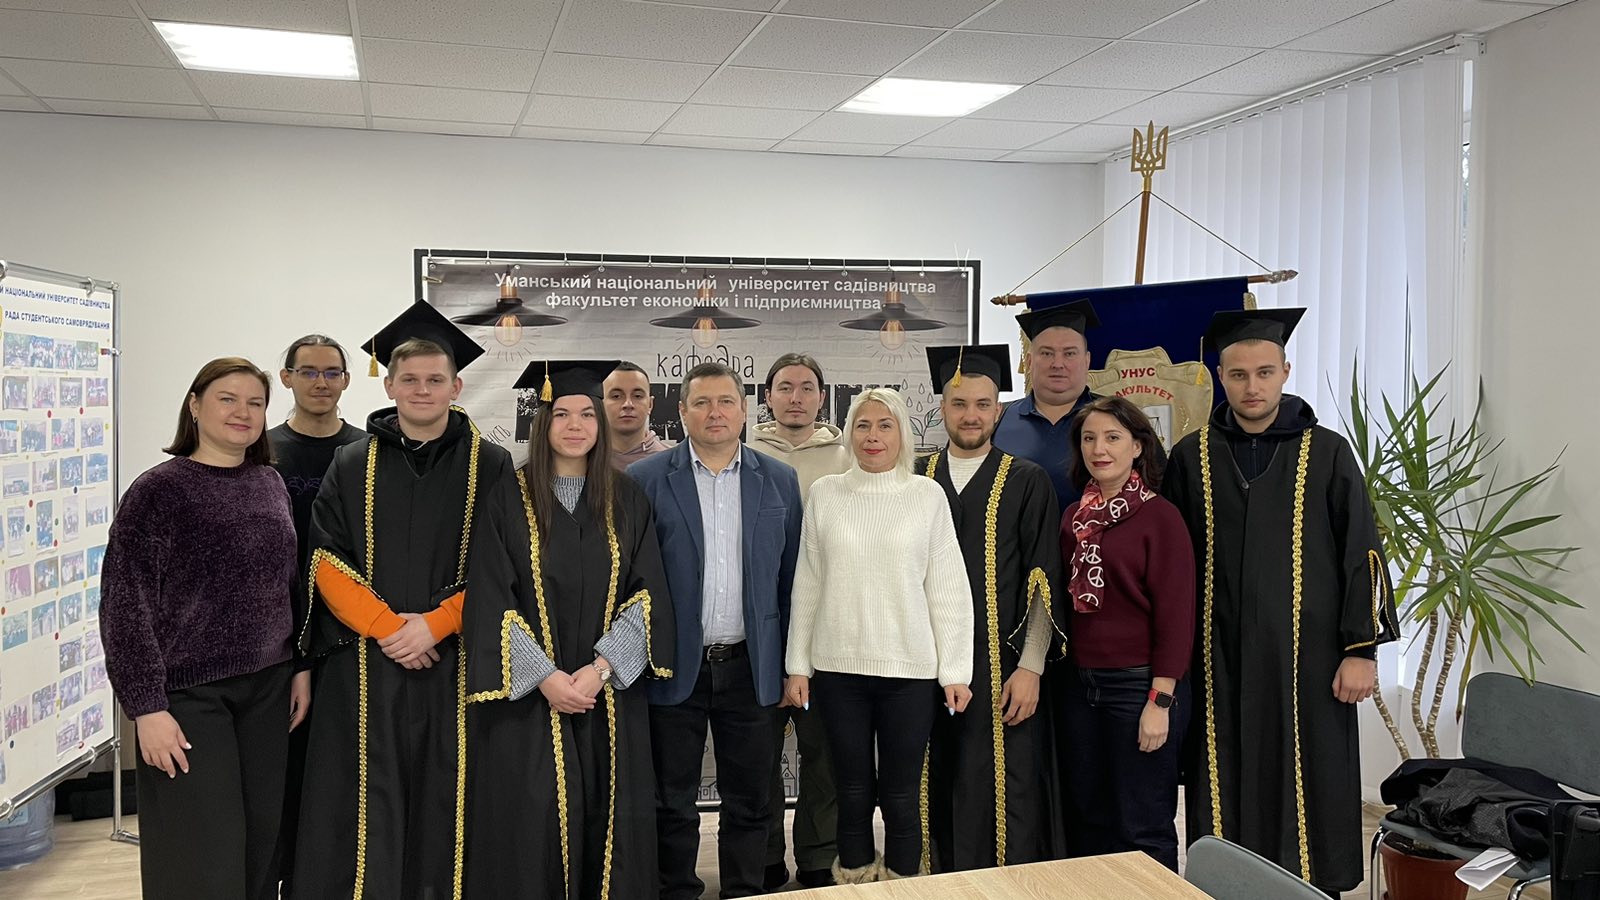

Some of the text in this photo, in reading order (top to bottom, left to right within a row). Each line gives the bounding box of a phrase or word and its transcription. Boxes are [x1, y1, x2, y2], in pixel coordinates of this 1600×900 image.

[494, 273, 937, 296] Уманський національний університет садівництва
[4, 286, 46, 299] НАЦІОНАЛЬНИЙ
[46, 294, 79, 304] УНІВЕРСИТЕТ
[79, 298, 111, 309] САДІВНИЦТВА
[545, 292, 638, 310] факультет
[642, 293, 729, 308] економіки
[734, 294, 739, 308] і
[4, 310, 110, 330] РАДА СТУДЕНТСЬКОГО САМОВРЯДУВАННЯ
[1121, 367, 1156, 379] УНУС
[1115, 384, 1174, 401] АКУЛЬТЕТ
